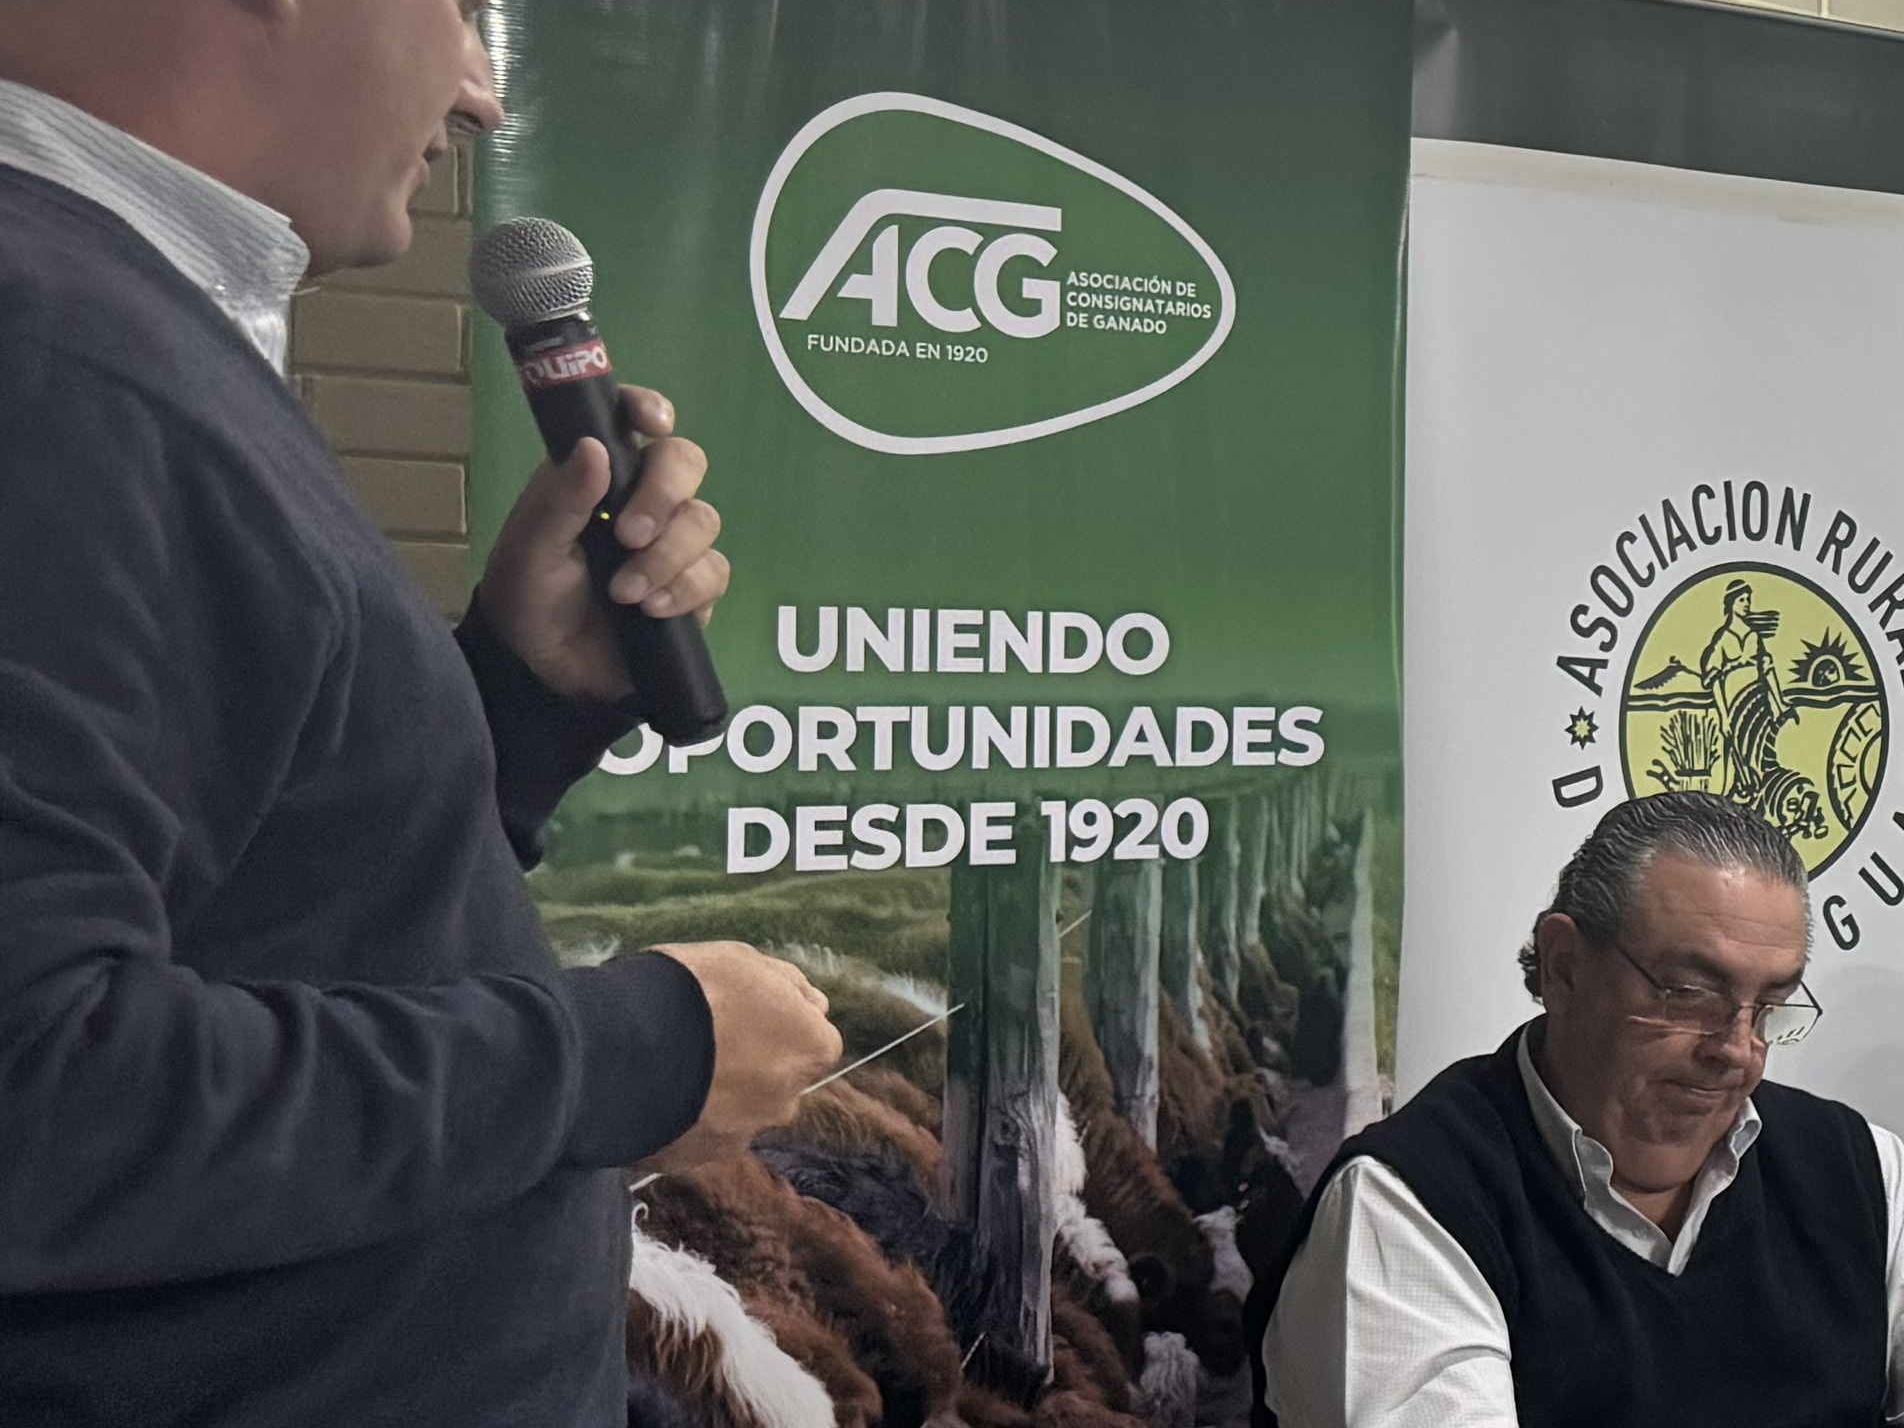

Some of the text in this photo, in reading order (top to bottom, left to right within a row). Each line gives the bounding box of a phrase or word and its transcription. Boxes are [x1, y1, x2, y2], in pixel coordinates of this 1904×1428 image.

[779, 189, 1062, 338] ACG
[1066, 271, 1197, 298] ASOCIACIÓN DE
[1066, 291, 1212, 319] CONSIGNATARIOS
[1066, 313, 1168, 335] DE GANADO
[807, 334, 989, 363] FUNDADA EN 1920
[1556, 480, 1811, 698] ASOCIACION
[777, 605, 1170, 675] UNIENDO
[727, 797, 1210, 873] DESDE 1920
